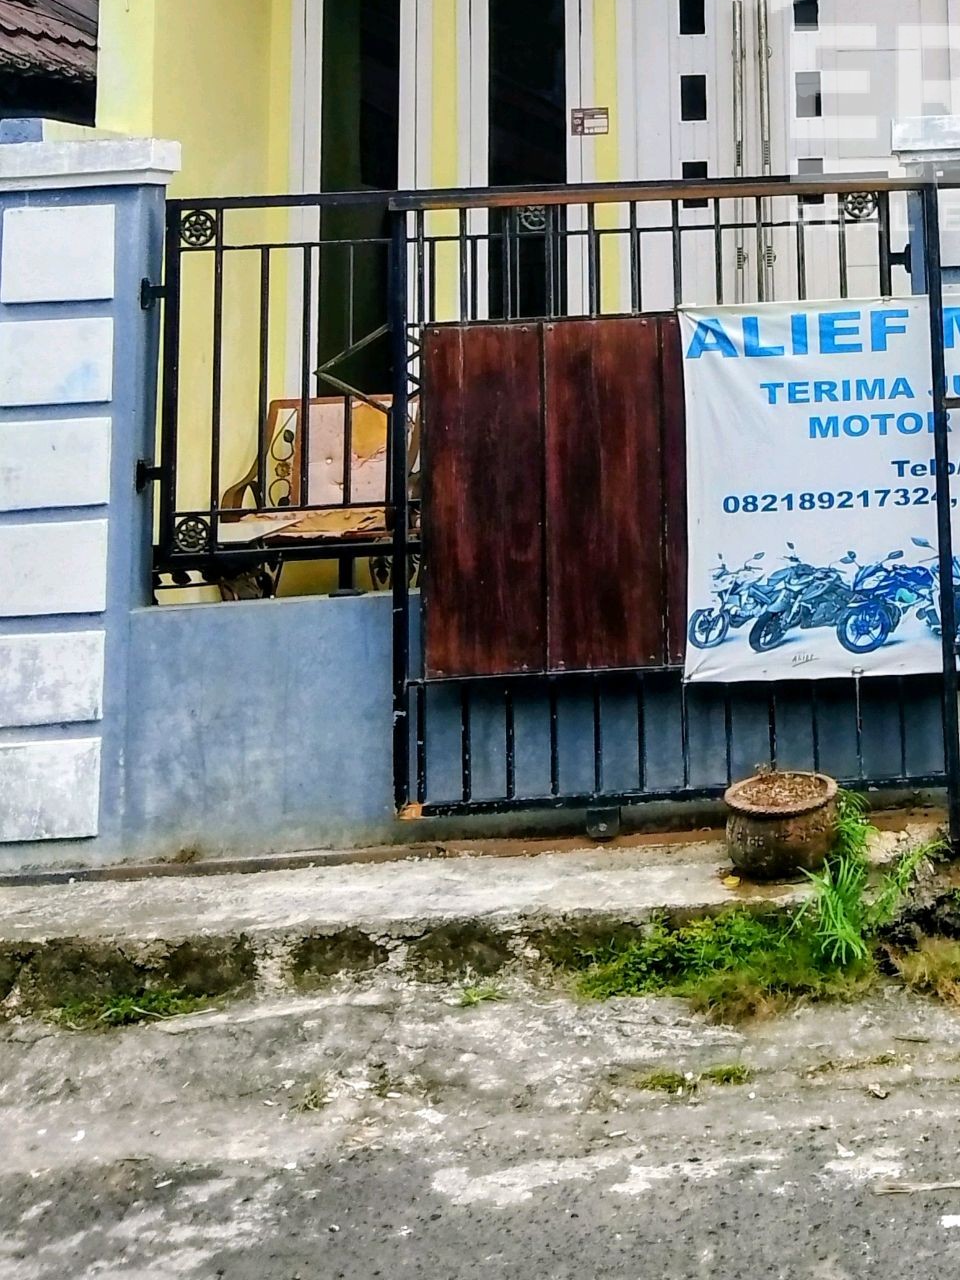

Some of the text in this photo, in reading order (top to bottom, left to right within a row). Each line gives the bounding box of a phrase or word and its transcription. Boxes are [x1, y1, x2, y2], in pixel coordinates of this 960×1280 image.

[686, 309, 909, 360] ALIEF
[760, 377, 915, 405] TERIMA
[723, 486, 958, 514] 08218921732,
